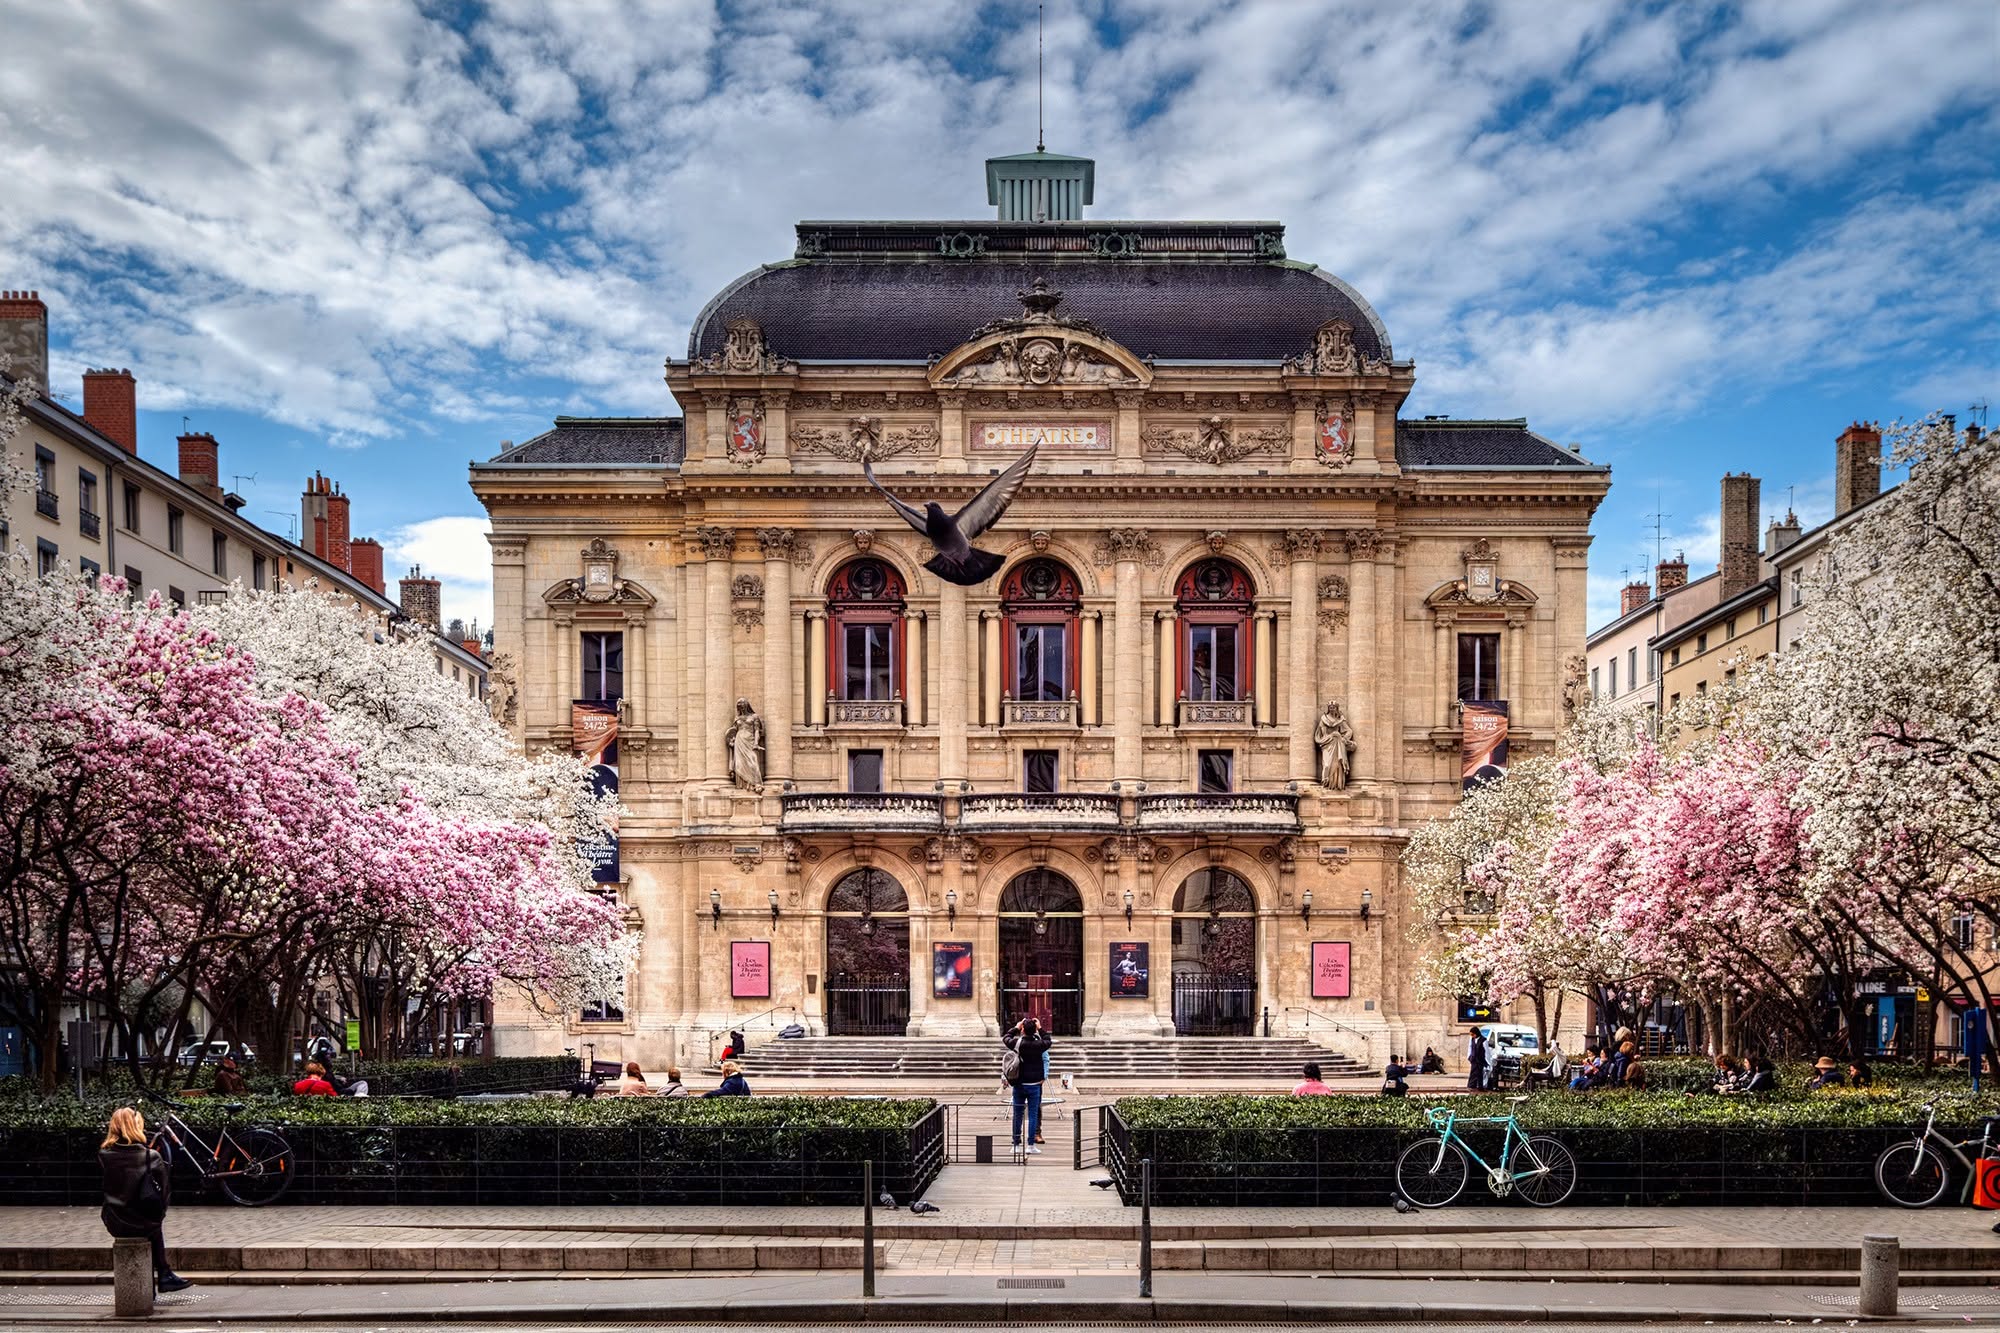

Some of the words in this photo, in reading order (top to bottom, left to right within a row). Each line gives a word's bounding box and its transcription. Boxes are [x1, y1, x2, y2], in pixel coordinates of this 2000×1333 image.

[998, 428, 1084, 443] THEATRE
[582, 713, 608, 721] saison
[1472, 714, 1498, 722] saison
[583, 721, 608, 730] 24/25
[1473, 722, 1498, 731] 24/25
[1865, 981, 1887, 993] LOGE
